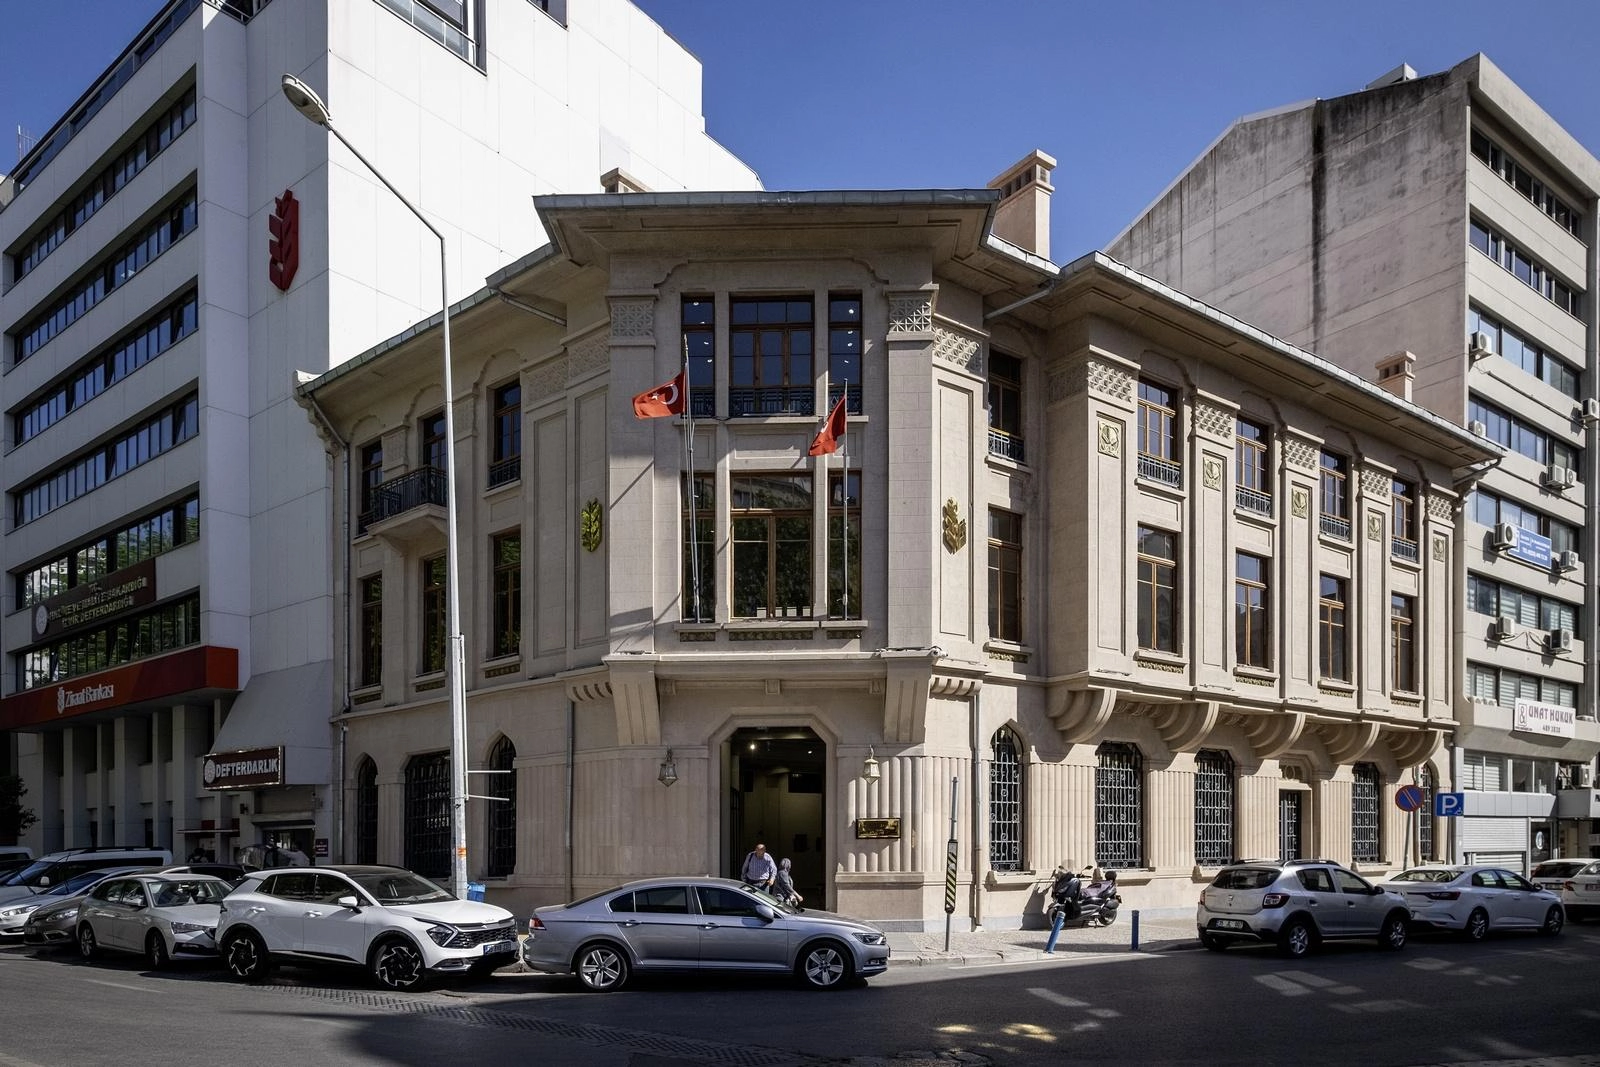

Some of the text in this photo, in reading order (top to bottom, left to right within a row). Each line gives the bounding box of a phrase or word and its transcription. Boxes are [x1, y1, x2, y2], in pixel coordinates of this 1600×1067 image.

[65, 688, 85, 708] Ziraat
[215, 758, 278, 778] DEFTERDARLIK
[1441, 795, 1458, 815] P
